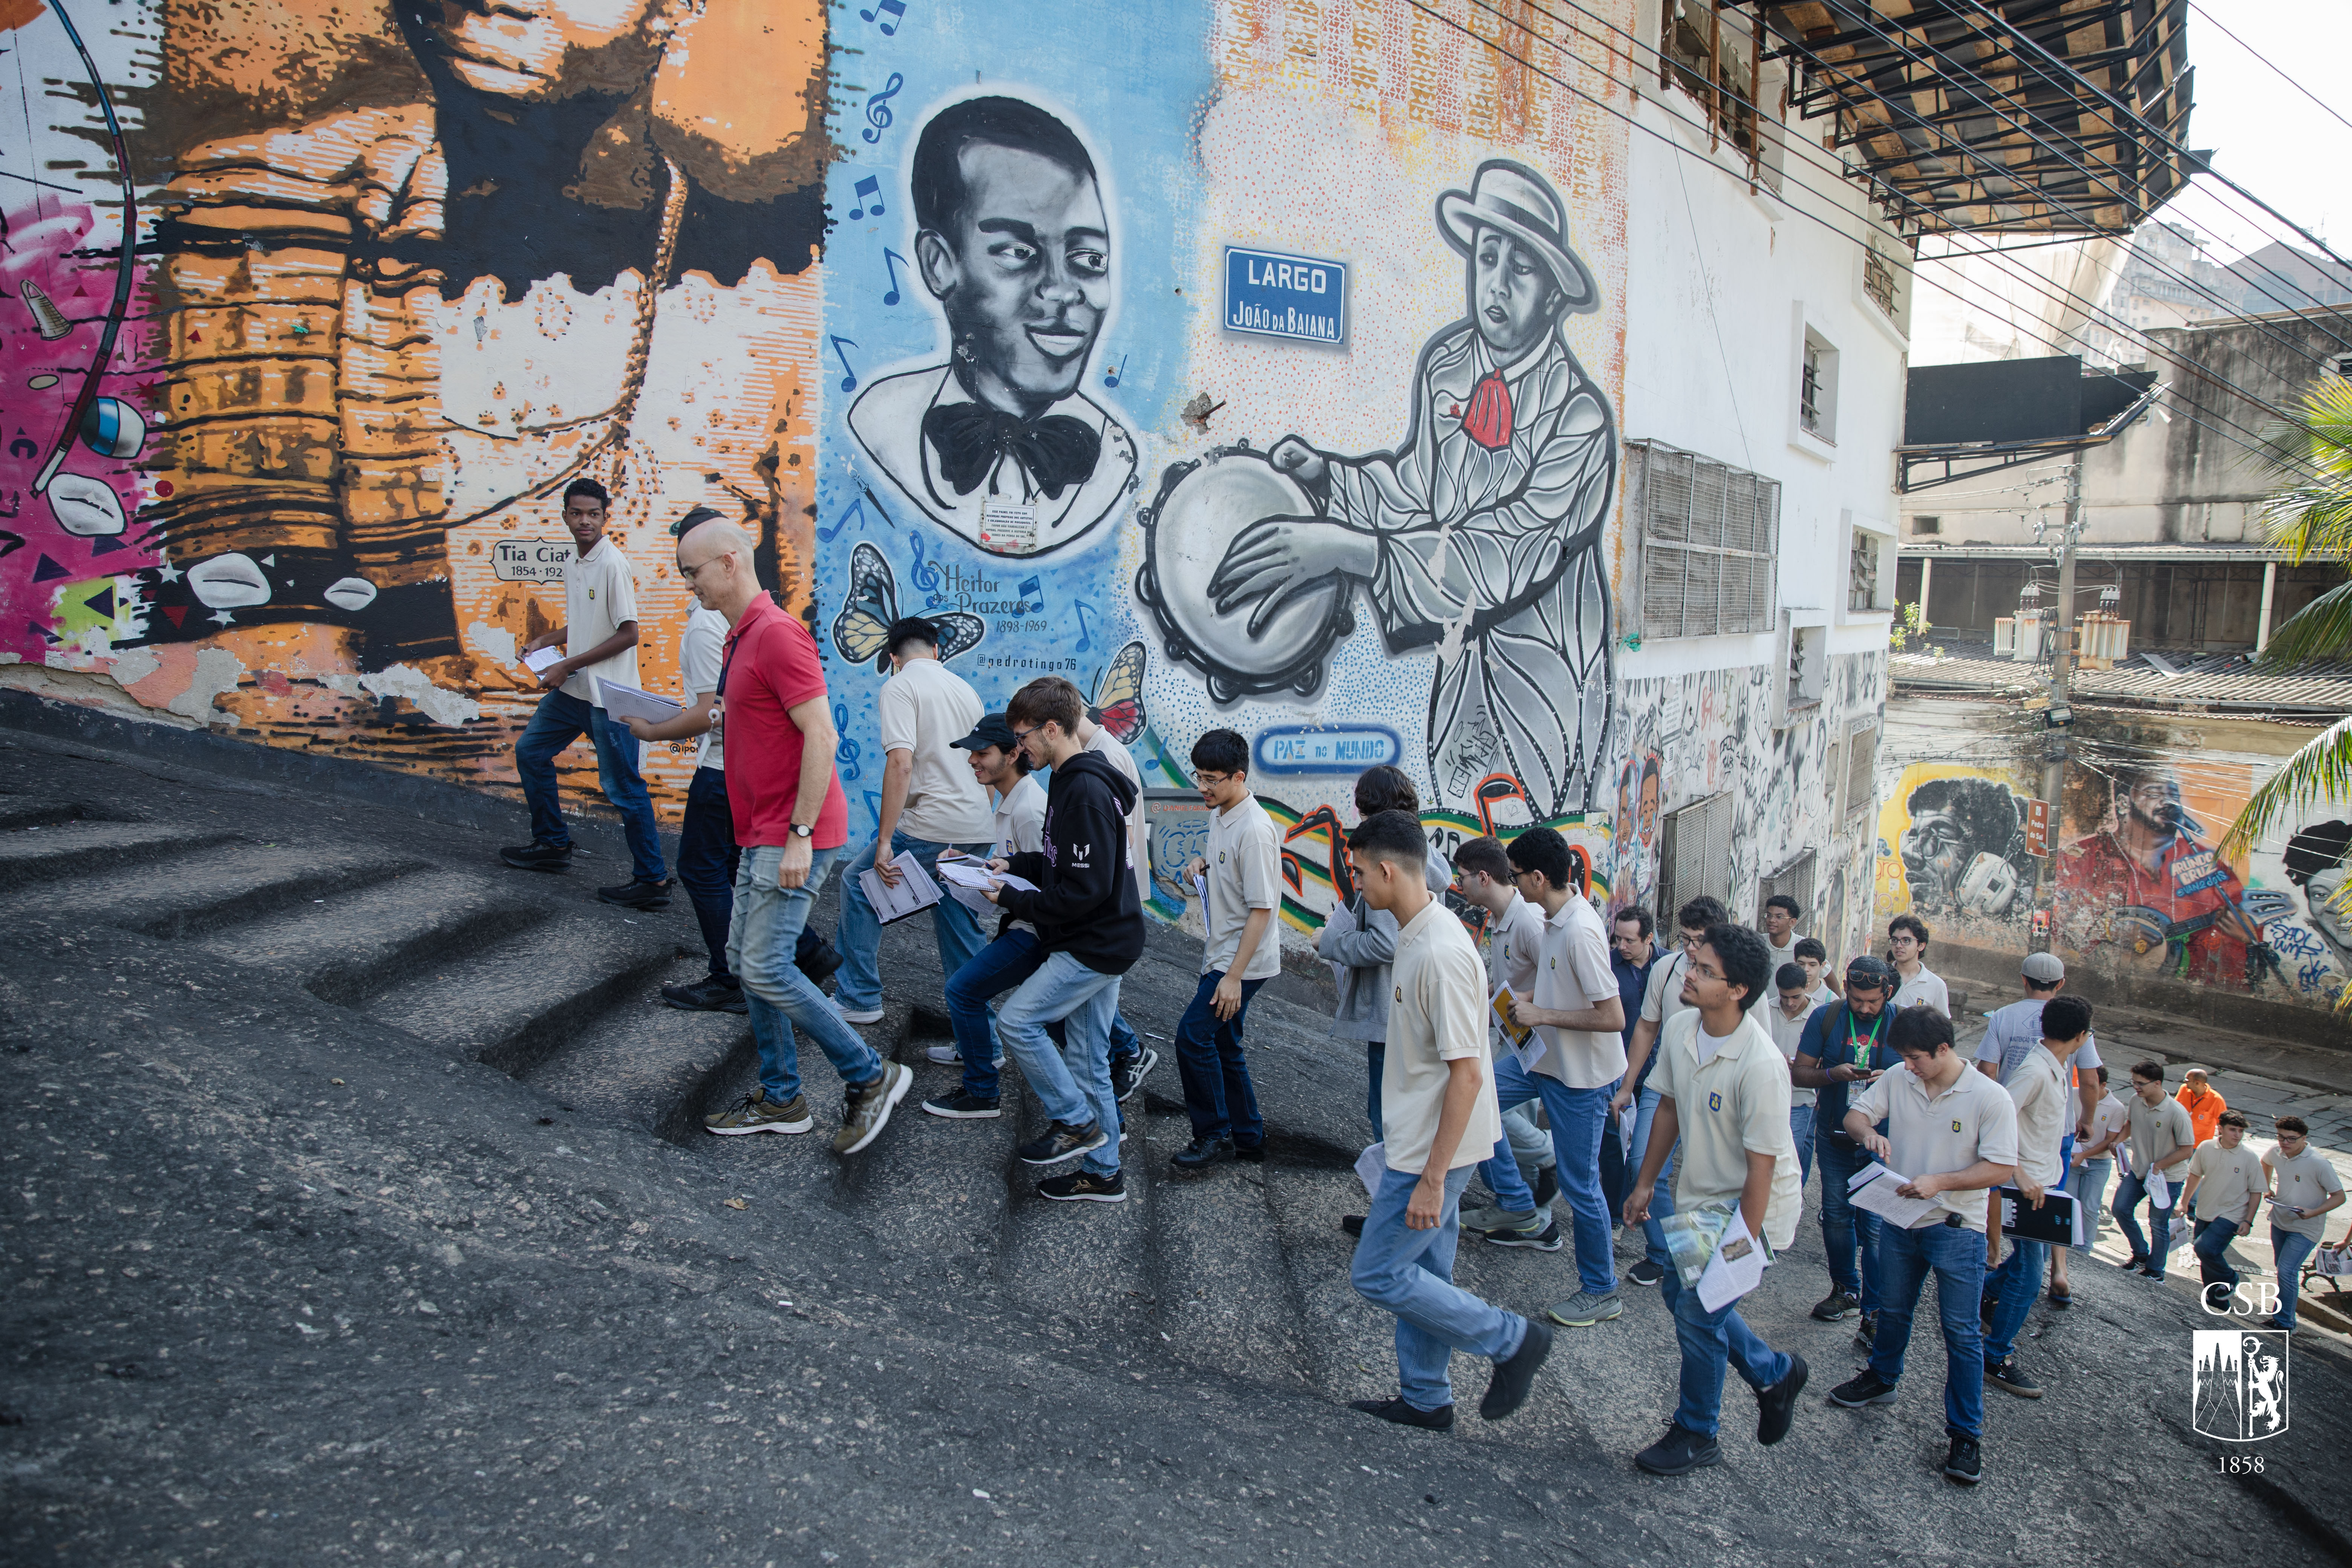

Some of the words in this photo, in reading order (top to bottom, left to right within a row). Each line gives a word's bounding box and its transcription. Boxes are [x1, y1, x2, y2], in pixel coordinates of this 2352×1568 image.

[1249, 259, 1326, 294] LARGO
[1233, 300, 1269, 329] JOÃO
[1272, 314, 1285, 331] DA
[1288, 307, 1335, 338] BAIANA
[499, 545, 527, 561] Tia
[545, 567, 564, 577] 192
[928, 560, 1000, 593] Heitor
[933, 589, 949, 602] dos
[949, 591, 1033, 614] Prazeres
[995, 620, 1047, 633] 1898-1969
[1274, 740, 1306, 760] PAZ
[1335, 740, 1384, 761] MUNDO
[2031, 819, 2044, 829] Pedra
[2179, 863, 2217, 886] CRUZ
